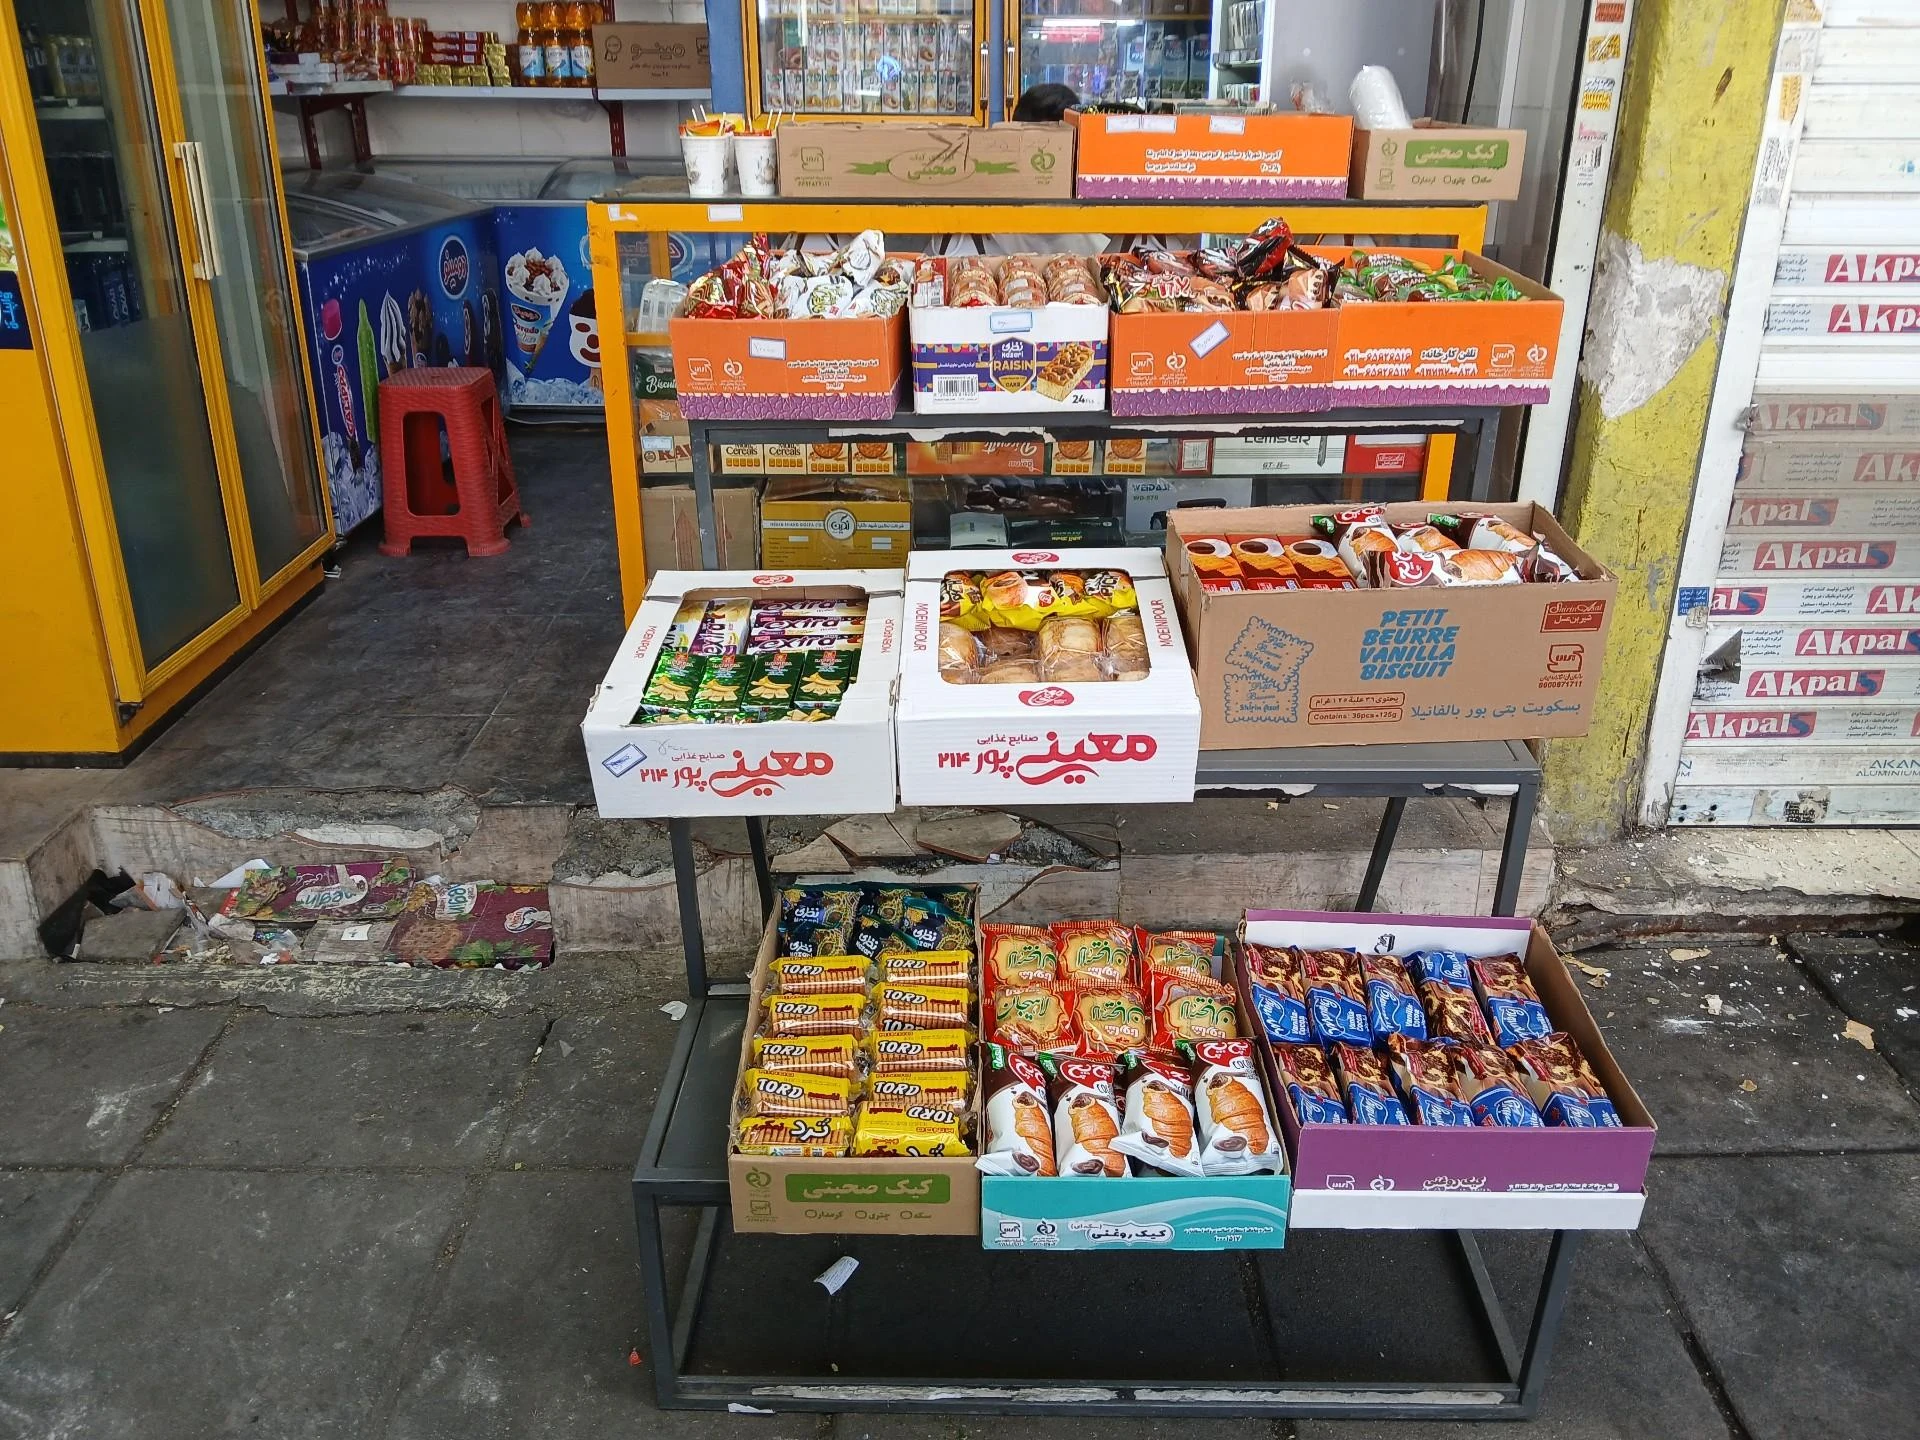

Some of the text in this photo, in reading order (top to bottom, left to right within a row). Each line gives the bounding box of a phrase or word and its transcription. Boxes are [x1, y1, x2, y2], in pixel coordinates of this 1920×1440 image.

[1415, 144, 1498, 165] کیک صحبتی
[1457, 348, 1477, 361] تلفن
[993, 360, 1034, 371] RAISIN
[1072, 394, 1085, 404] 24
[726, 446, 758, 456] Cereals
[769, 446, 801, 456] Cereals
[764, 617, 839, 630] extra
[1150, 598, 1174, 648] MOEINIPOUR
[1380, 608, 1449, 628] PETIT
[913, 602, 929, 652] MOEINIPOUR
[702, 621, 726, 655] extra
[759, 635, 836, 650] extra
[1362, 626, 1460, 646] BEURRE
[1359, 643, 1456, 664] VANILLA
[1360, 661, 1453, 681] BISCUIT
[976, 733, 1039, 747] صنایع غذایی
[671, 752, 726, 763] صنایع غذایی
[972, 748, 1015, 779] پور
[1016, 731, 1158, 785] معینی
[671, 766, 709, 793] پور
[708, 749, 834, 798] معینی
[794, 907, 820, 918] نظری
[858, 932, 880, 951] نظری
[912, 928, 937, 942] نظری
[789, 941, 813, 954] نظری
[782, 964, 825, 976] TORD
[885, 957, 927, 970] TORD
[884, 988, 926, 1005] TORD
[774, 1001, 819, 1016] TORD
[761, 1043, 807, 1057] TORD
[878, 1039, 923, 1055] TORD
[756, 1077, 804, 1100] TORD
[873, 1080, 921, 1097] TORD
[906, 1105, 956, 1124] TORD
[802, 1178, 934, 1200] کیک صحبتی
[1462, 1176, 1486, 1188] کیک
[868, 1210, 890, 1222] چتری
[912, 1209, 932, 1220] سکه
[1091, 1228, 1167, 1243] کیک روغنی
